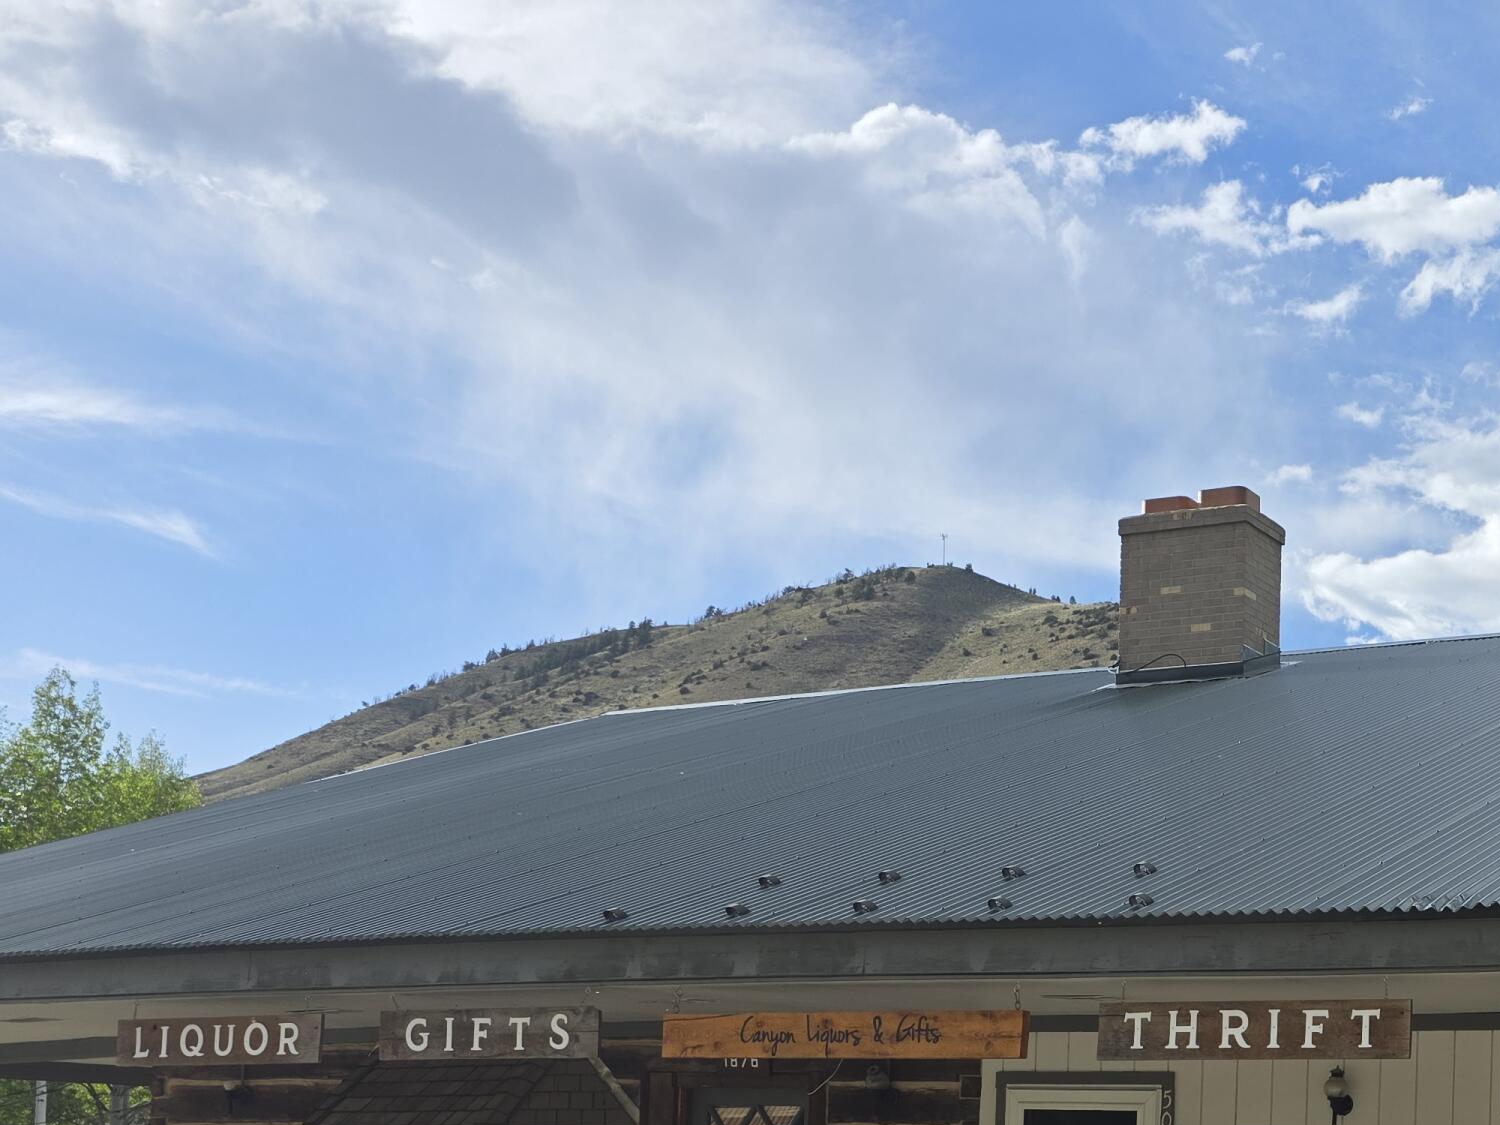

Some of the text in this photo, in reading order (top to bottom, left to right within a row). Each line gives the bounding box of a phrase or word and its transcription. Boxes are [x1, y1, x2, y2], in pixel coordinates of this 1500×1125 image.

[132, 1020, 300, 1059] LIQUOR
[404, 1013, 571, 1053] GIFTS
[739, 1013, 942, 1058] Canyon Liquors & Gifts
[1123, 1008, 1381, 1050] THRIFT
